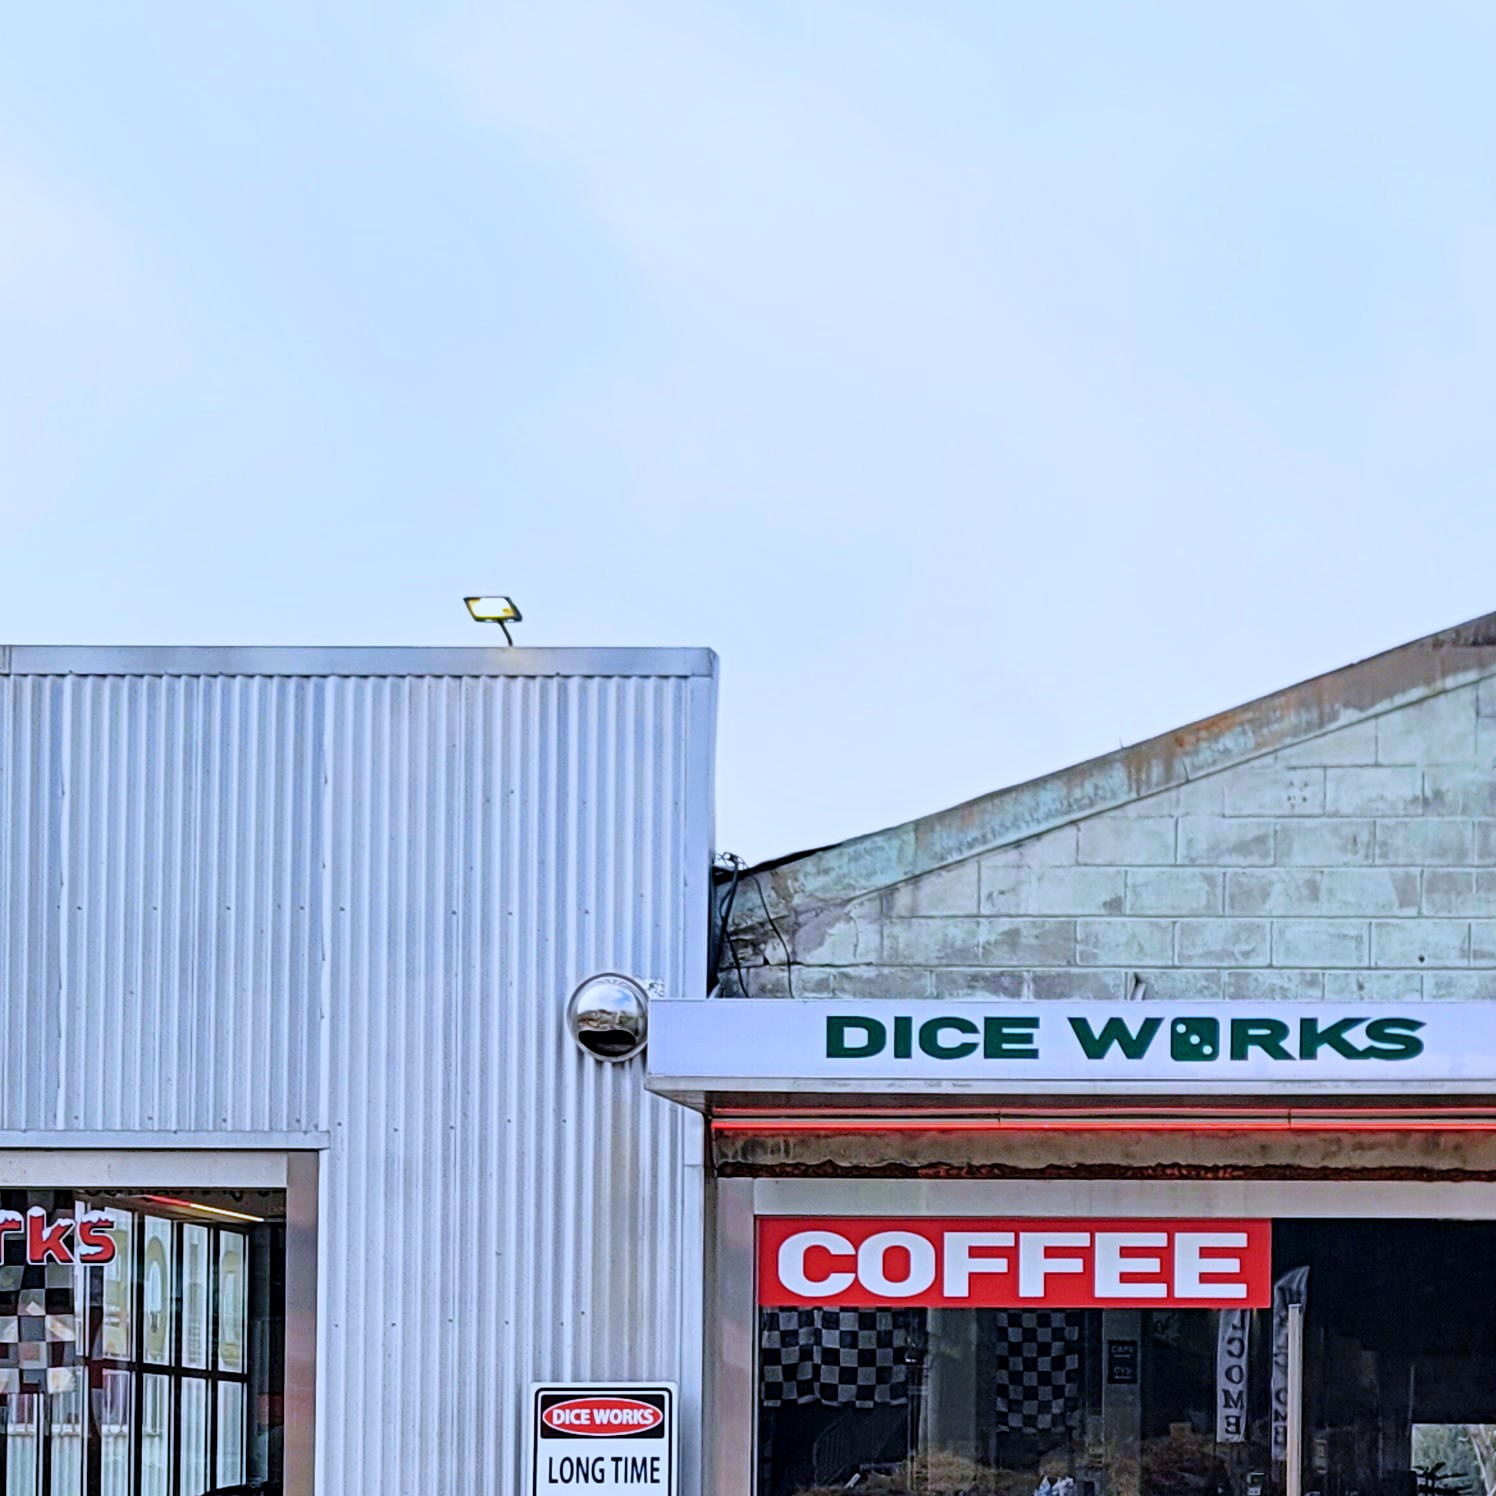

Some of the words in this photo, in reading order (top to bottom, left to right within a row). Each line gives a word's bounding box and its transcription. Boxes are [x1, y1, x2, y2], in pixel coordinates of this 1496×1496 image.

[825, 1015, 1040, 1059] DICE
[777, 1230, 1249, 1299] COFFEE
[552, 1409, 591, 1425] DICE
[592, 1409, 655, 1425] WORKS
[548, 1456, 605, 1484] LONG
[610, 1456, 661, 1484] TIME
